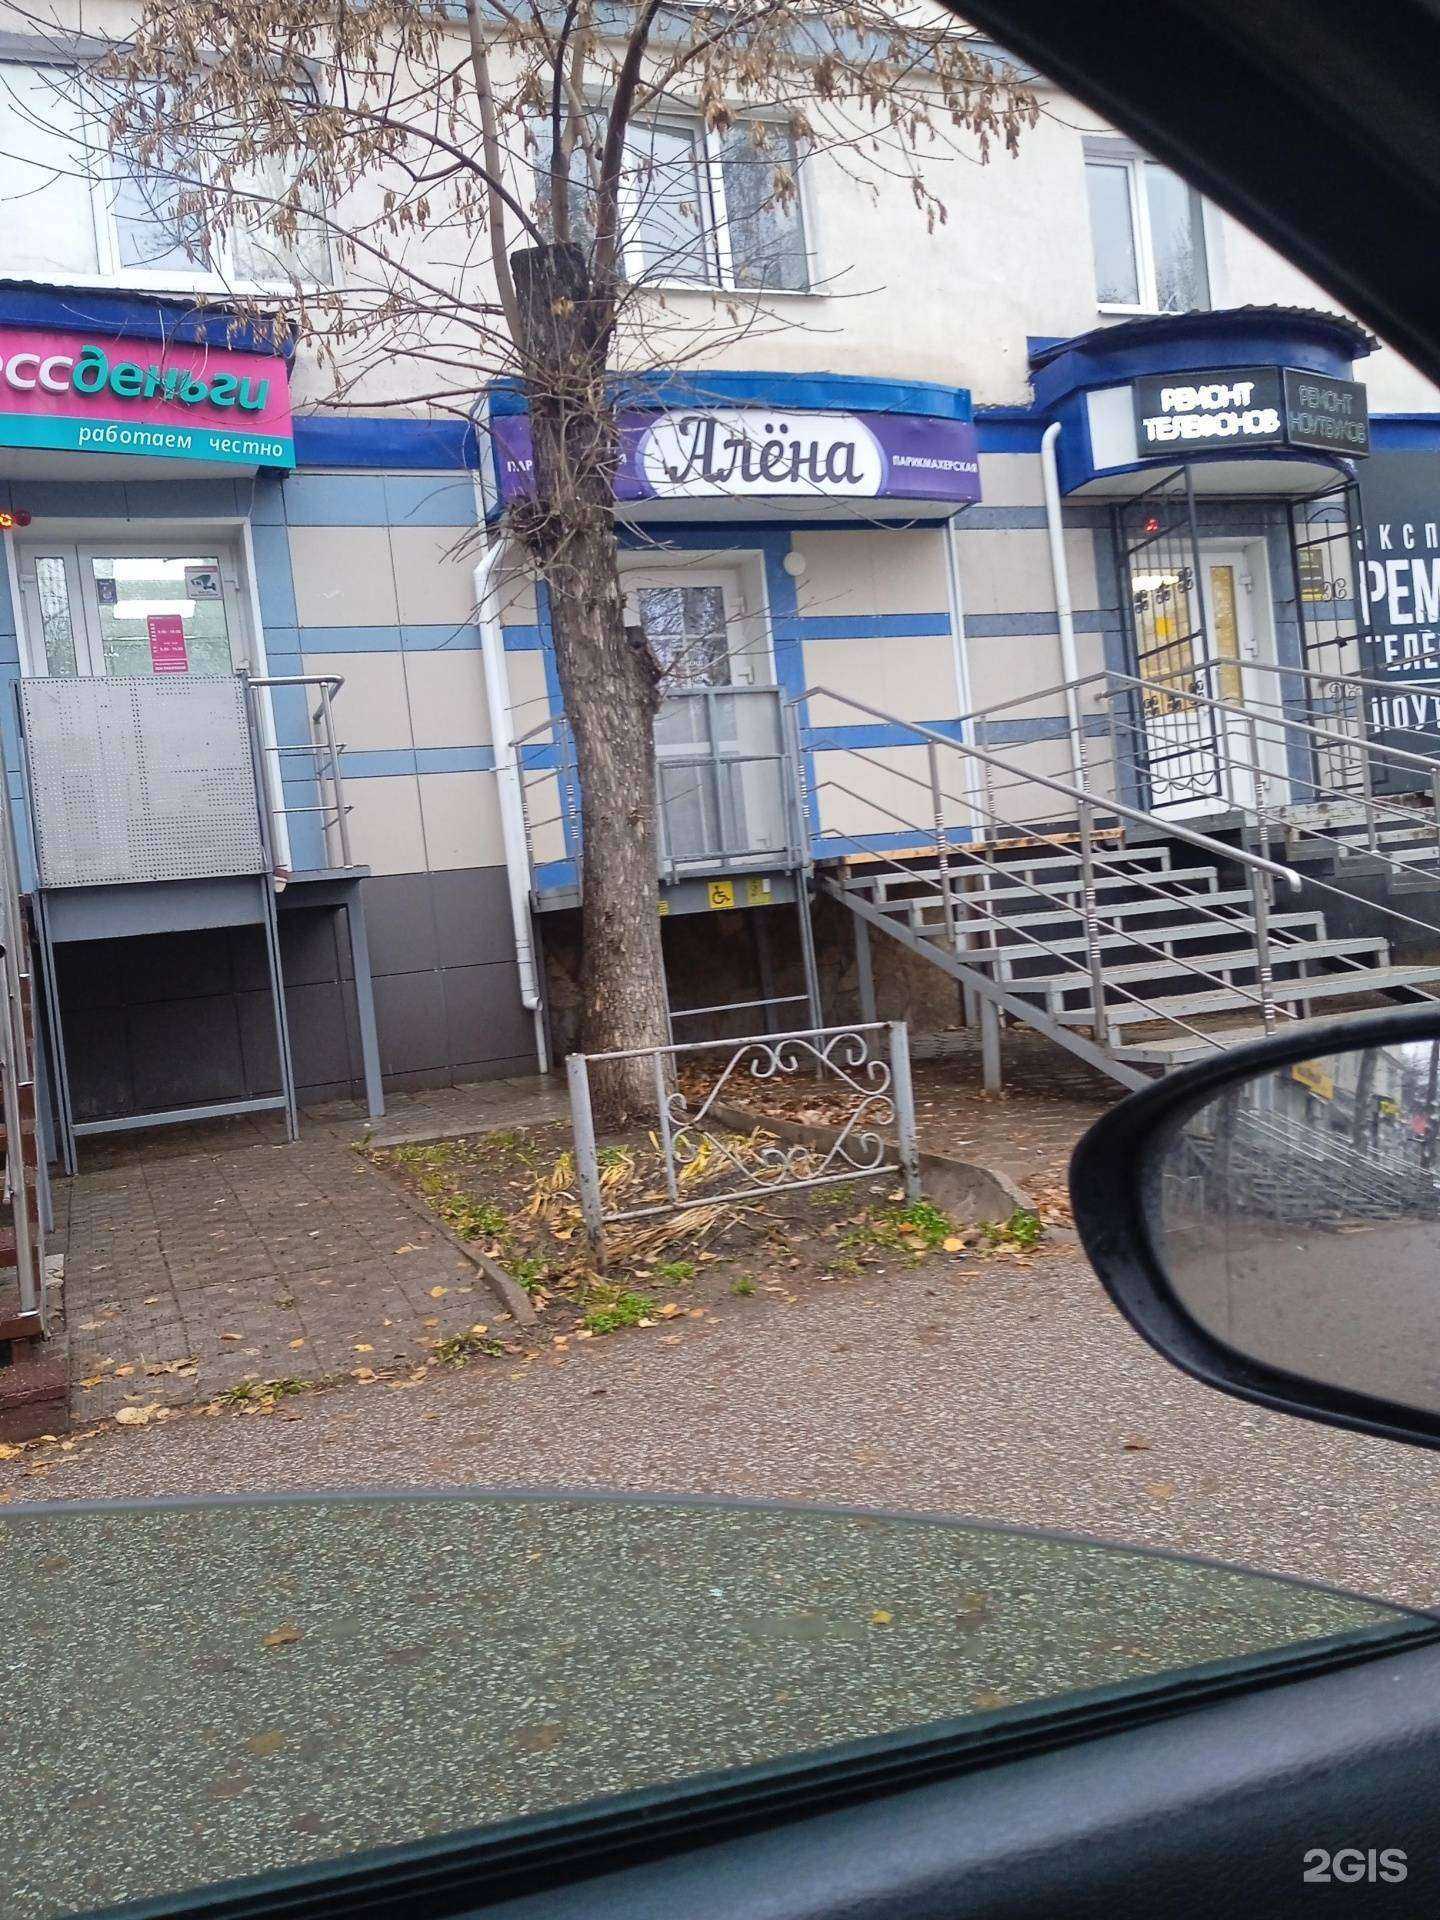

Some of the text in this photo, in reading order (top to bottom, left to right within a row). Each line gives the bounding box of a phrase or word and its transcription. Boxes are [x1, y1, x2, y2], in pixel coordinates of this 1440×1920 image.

[0, 345, 270, 411] ссденьги
[1161, 382, 1255, 413] РЕМОНТ
[1143, 408, 1281, 441] ТЕЛЕФОНОВ
[78, 425, 284, 457] работаем честно
[664, 416, 864, 484] Алёна
[892, 454, 978, 473] ПАРИКМАХЕРСКАЯ
